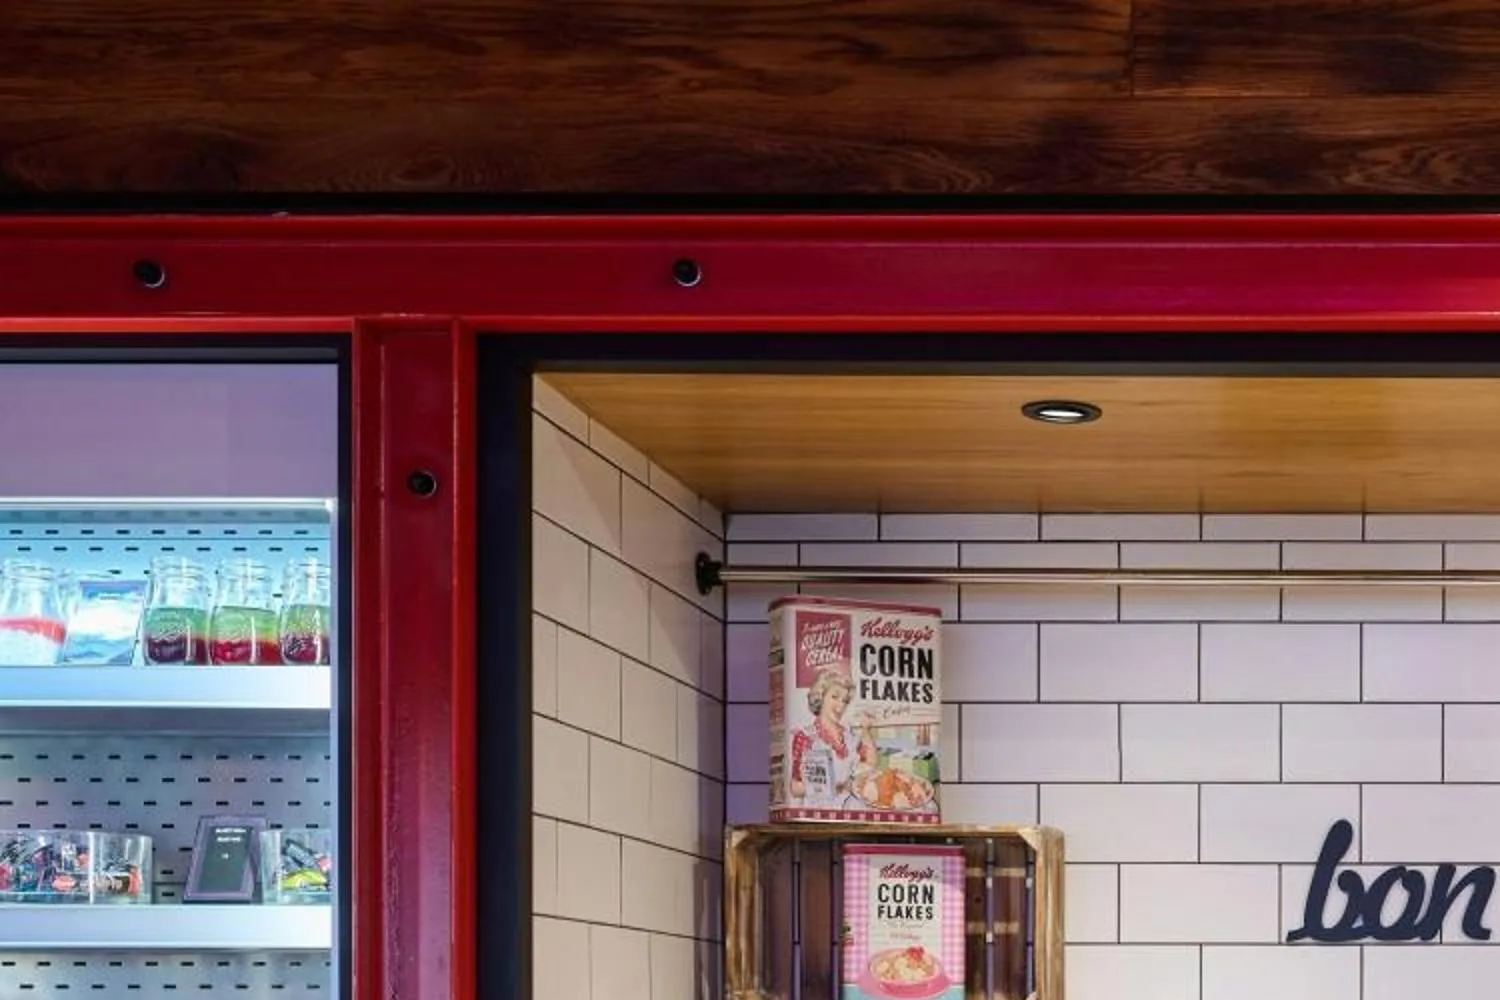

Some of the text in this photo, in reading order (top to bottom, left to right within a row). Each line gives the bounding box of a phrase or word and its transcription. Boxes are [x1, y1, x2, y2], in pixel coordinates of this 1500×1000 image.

[861, 617, 934, 646] Kellogg's
[860, 643, 933, 679] CORN
[860, 679, 933, 704] FLAKES
[1286, 819, 1496, 942] bon
[877, 884, 934, 905] CORN
[877, 905, 934, 920] FLAKES
